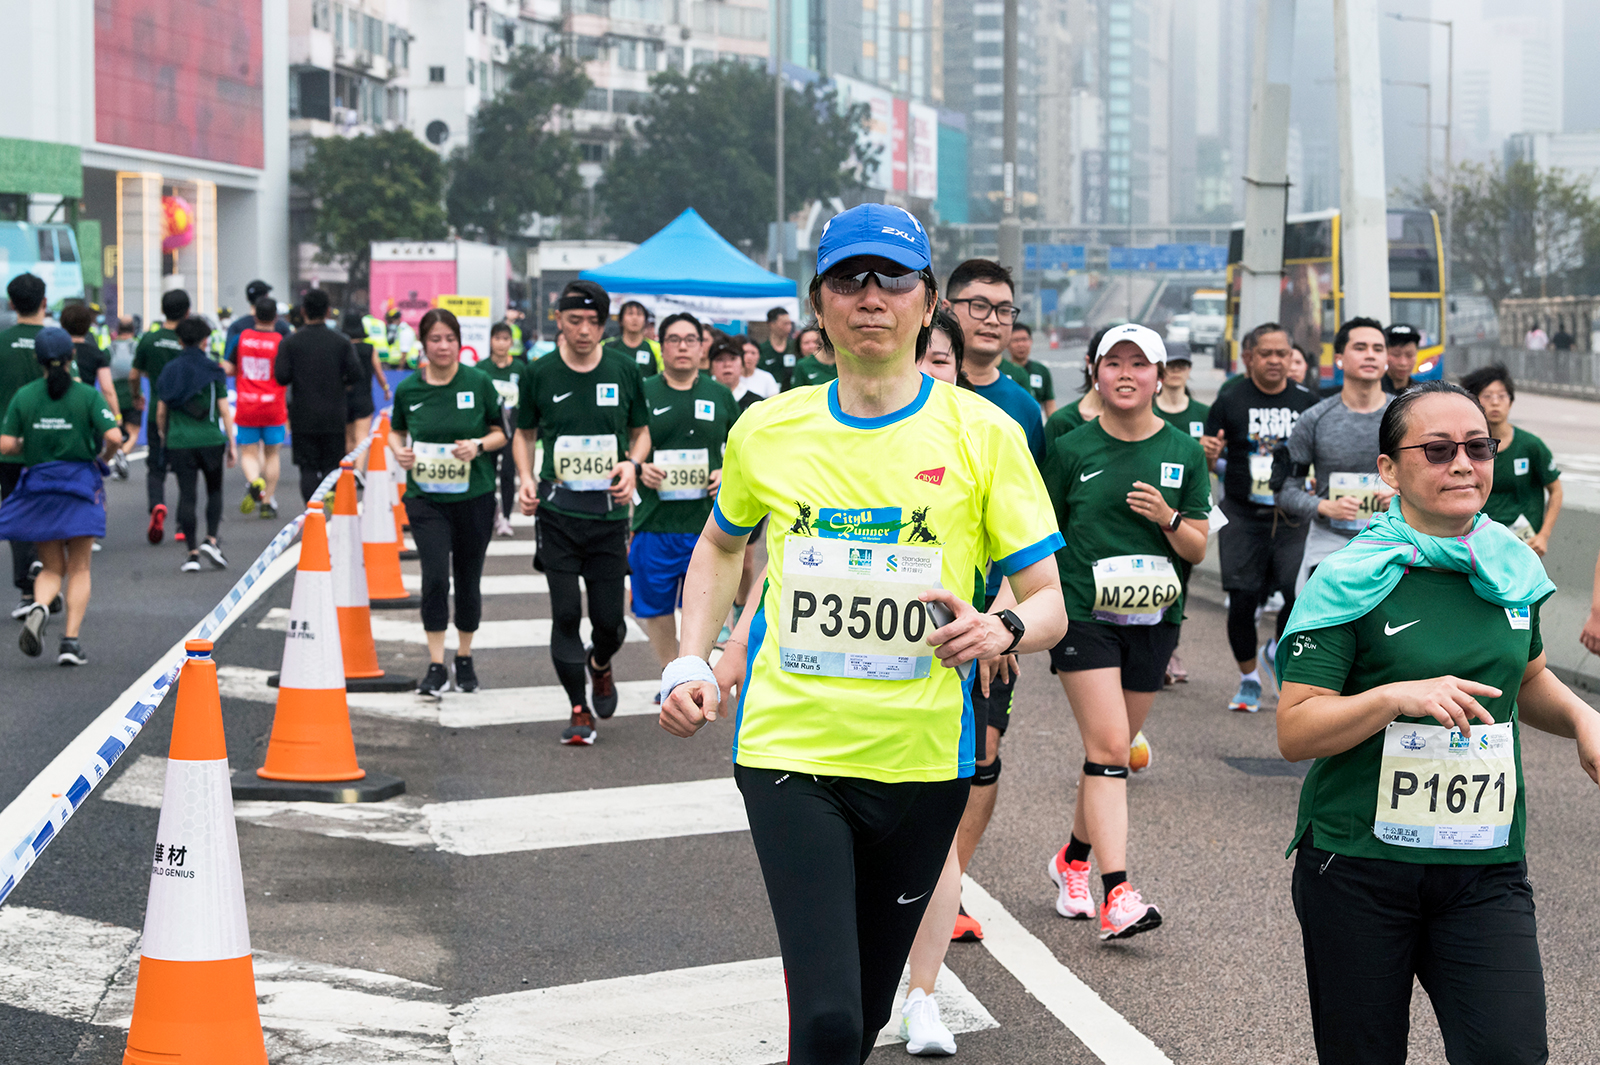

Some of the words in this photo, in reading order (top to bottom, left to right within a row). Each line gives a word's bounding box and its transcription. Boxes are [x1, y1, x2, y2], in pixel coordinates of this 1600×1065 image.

[1248, 421, 1295, 438] PAWI
[416, 462, 466, 479] P3964
[560, 457, 613, 474] P3464
[829, 511, 873, 529] CityU
[838, 525, 890, 538] Runner
[1100, 584, 1177, 608] M2260
[790, 590, 926, 643] P3500
[1303, 642, 1317, 650] RUN
[784, 661, 799, 669] 10KM
[785, 653, 818, 663] 十公里五組
[1391, 771, 1505, 814] P1671
[1382, 833, 1400, 841] 10KM
[1401, 835, 1415, 843] Run
[1383, 827, 1418, 837] 十公里五組
[165, 868, 195, 879] GENIUS
